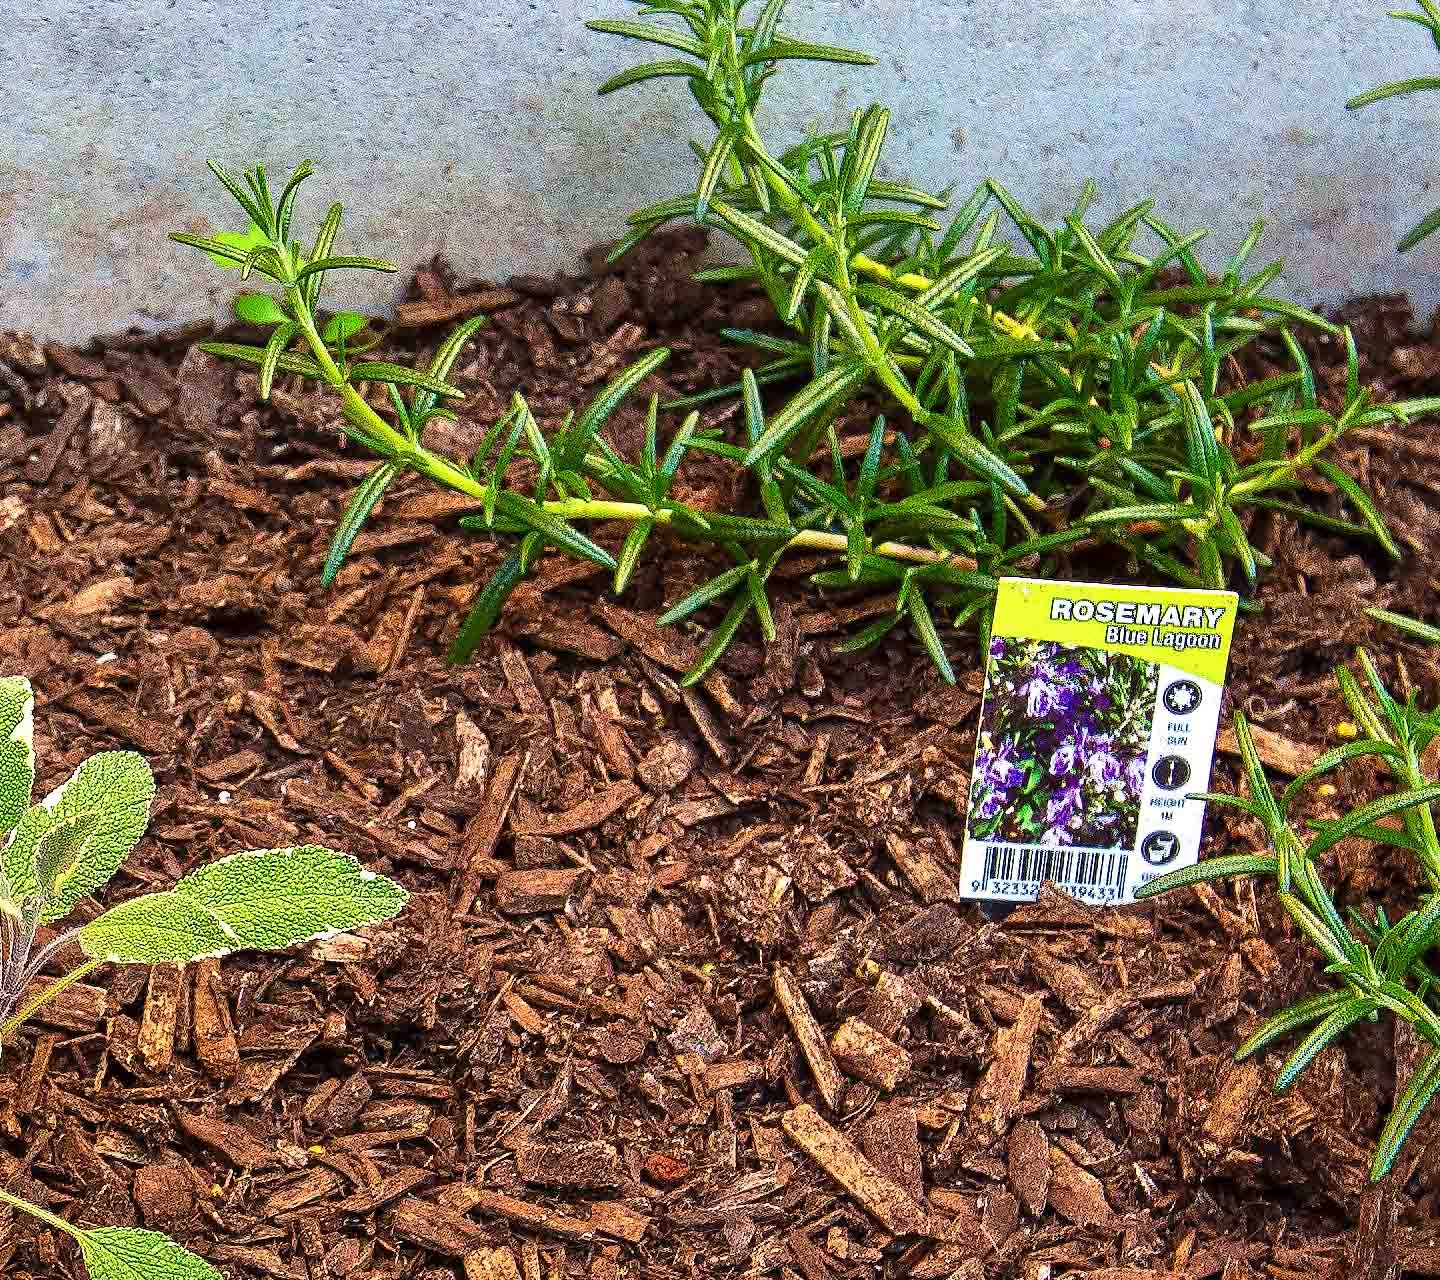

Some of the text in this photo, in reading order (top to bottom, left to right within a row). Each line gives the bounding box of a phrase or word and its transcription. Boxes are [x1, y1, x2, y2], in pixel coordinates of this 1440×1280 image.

[1050, 598, 1225, 628] ROSEMARY
[1105, 625, 1221, 652] Blue Lagoon
